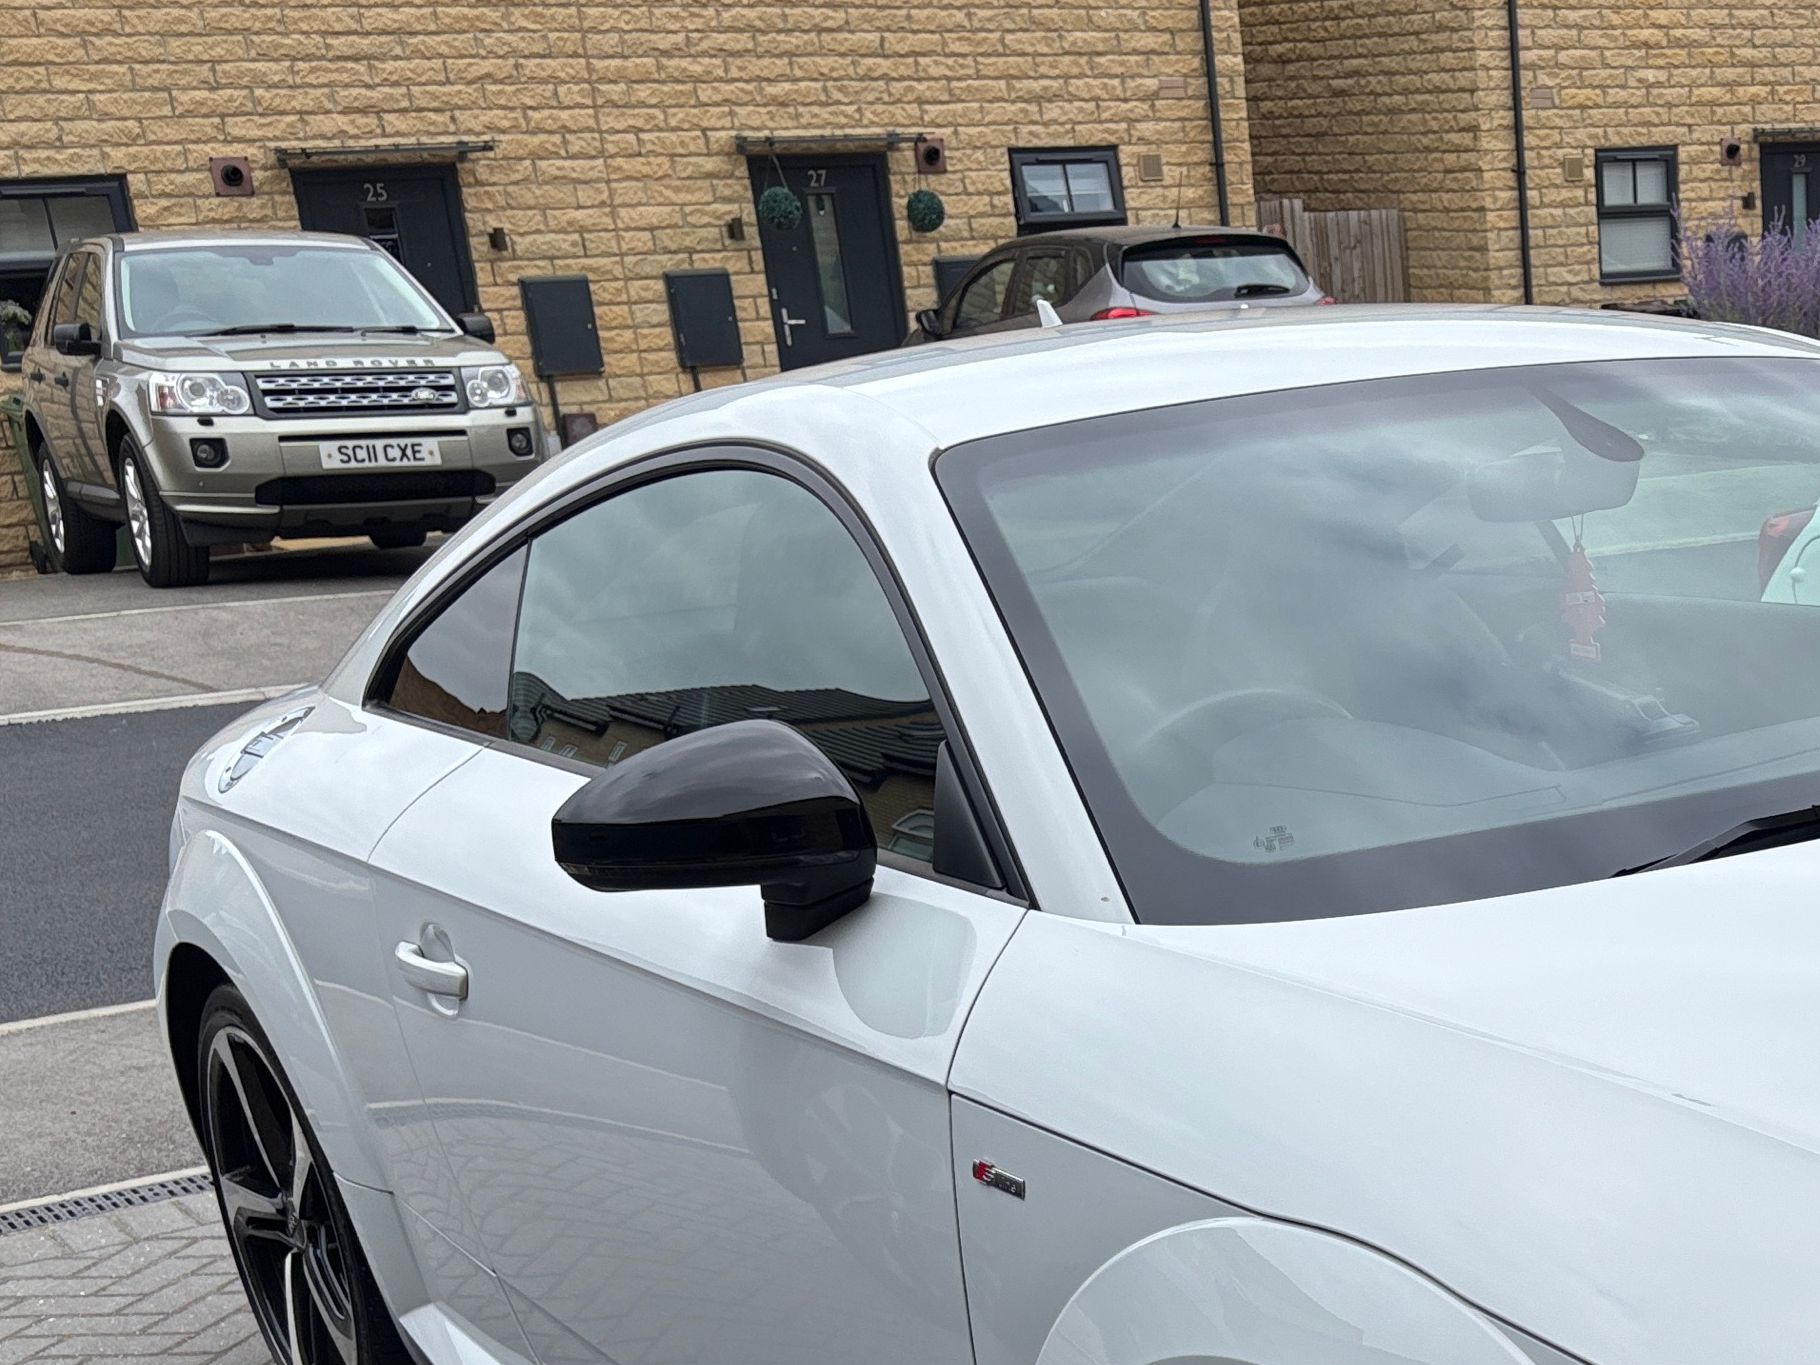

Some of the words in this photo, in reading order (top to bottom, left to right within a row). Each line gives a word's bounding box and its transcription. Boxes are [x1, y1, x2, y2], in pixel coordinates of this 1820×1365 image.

[1793, 154, 1807, 168] 29
[807, 169, 827, 187] 27
[363, 183, 388, 201] 25
[269, 360, 338, 369] LAND
[353, 359, 436, 368] ROVER
[383, 443, 426, 463] CXE
